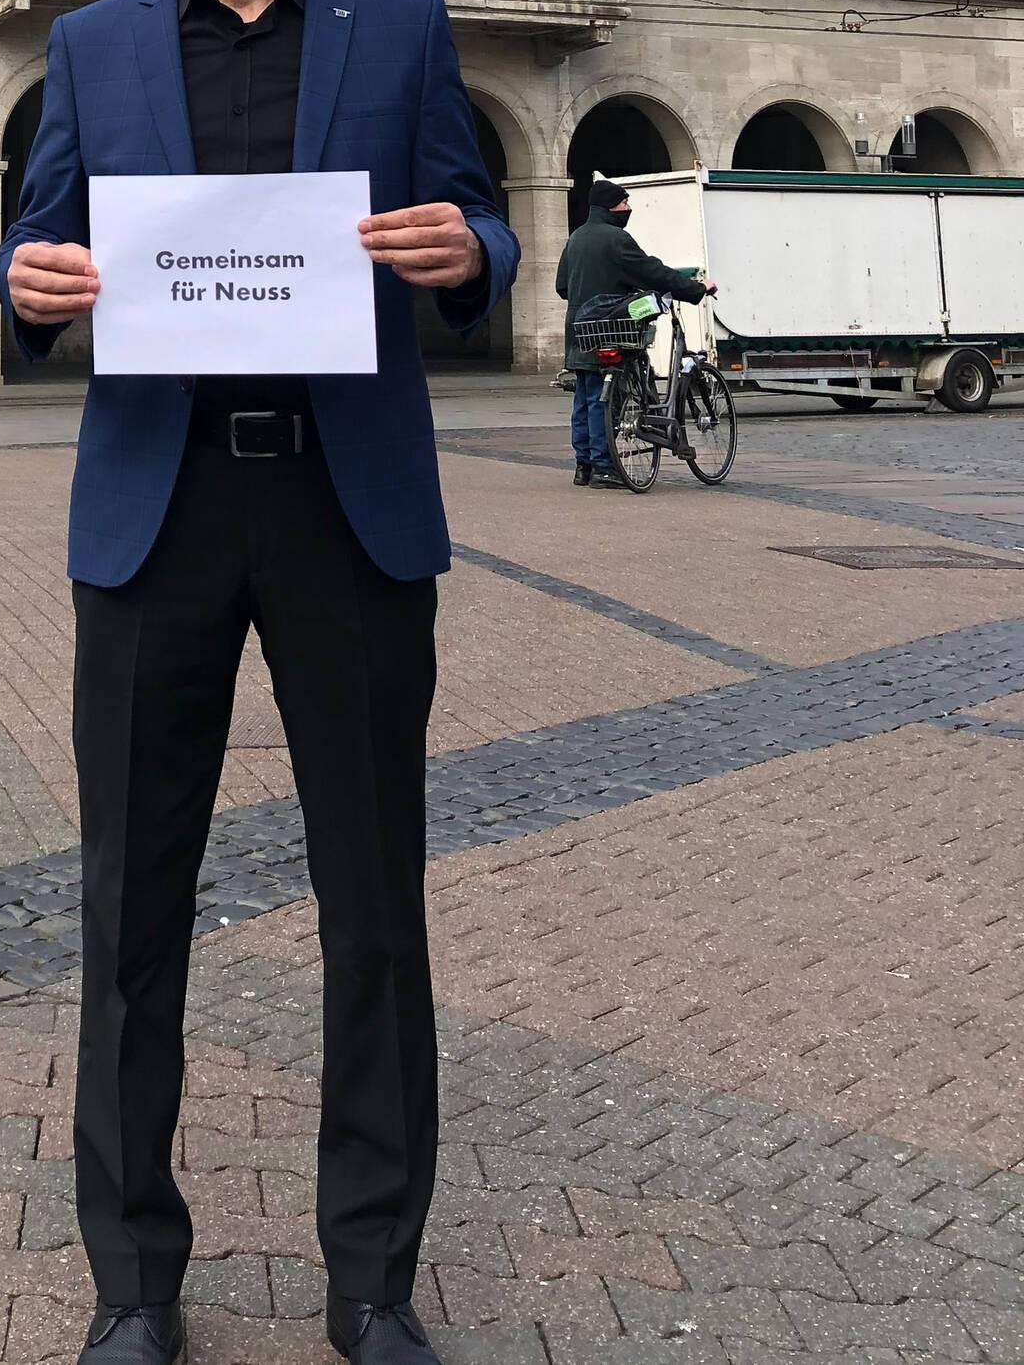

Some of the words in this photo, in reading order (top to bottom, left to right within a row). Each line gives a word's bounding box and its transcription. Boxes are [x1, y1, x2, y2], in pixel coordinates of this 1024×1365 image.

[155, 248, 305, 270] Gemeinsam
[170, 280, 207, 302] für
[215, 281, 292, 302] Neuss
